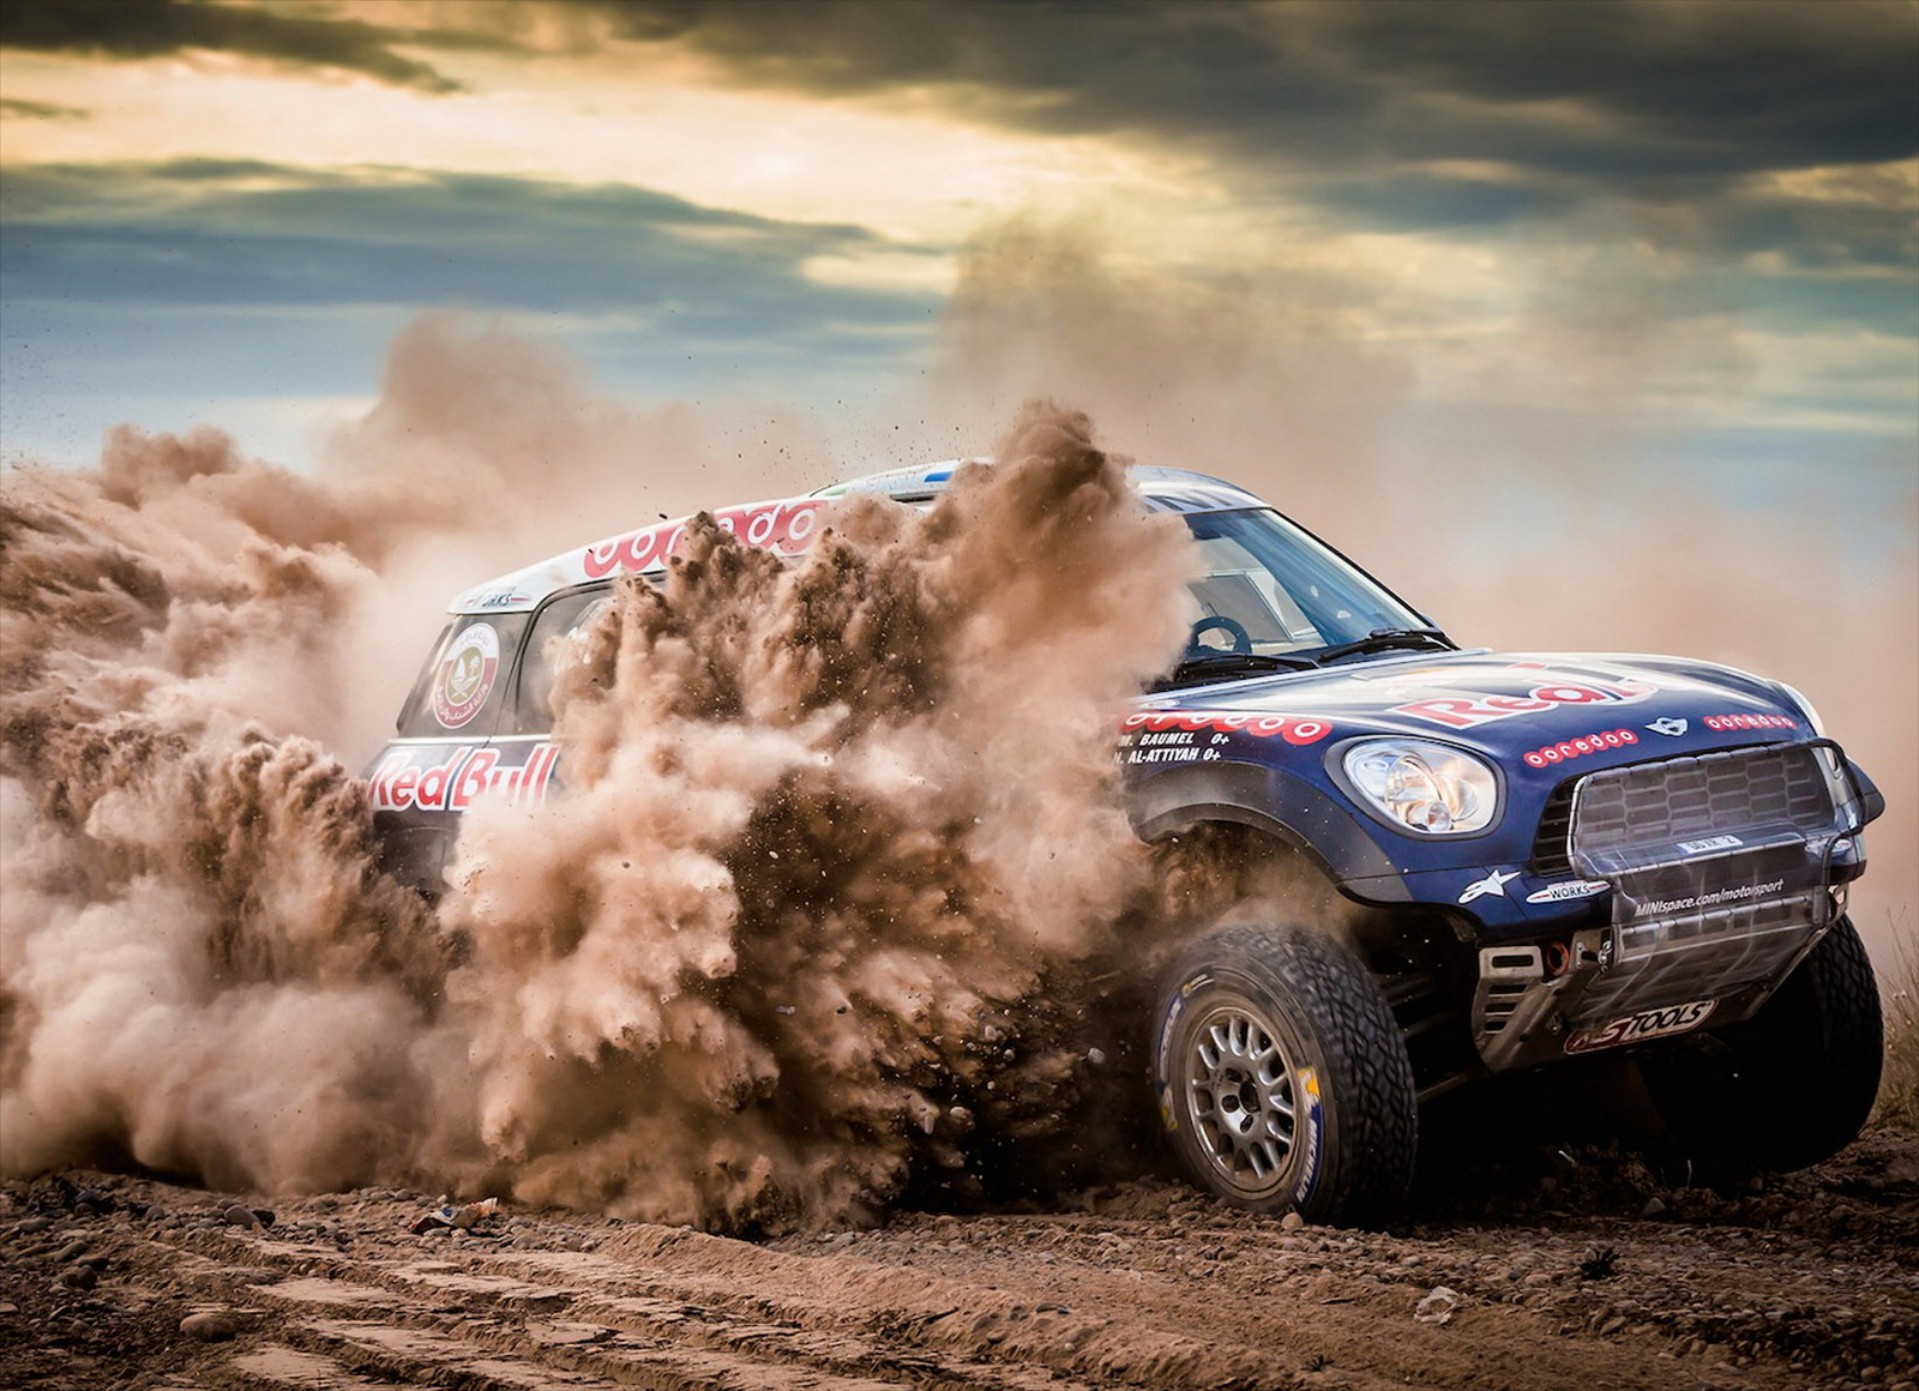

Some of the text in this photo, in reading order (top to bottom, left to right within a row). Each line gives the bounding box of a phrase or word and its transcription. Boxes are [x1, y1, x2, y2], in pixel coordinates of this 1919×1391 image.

[1705, 713, 1795, 731] ooredoo
[1139, 732, 1194, 746] BAUMEL
[1527, 728, 1635, 767] ooredoo
[1127, 747, 1200, 764] AL-ATTIYAH
[366, 746, 472, 811] Red
[1549, 884, 1590, 899] WORKS
[1634, 878, 1785, 918] MINIspace.com/motorsport
[1629, 1002, 1707, 1034] TOOLS
